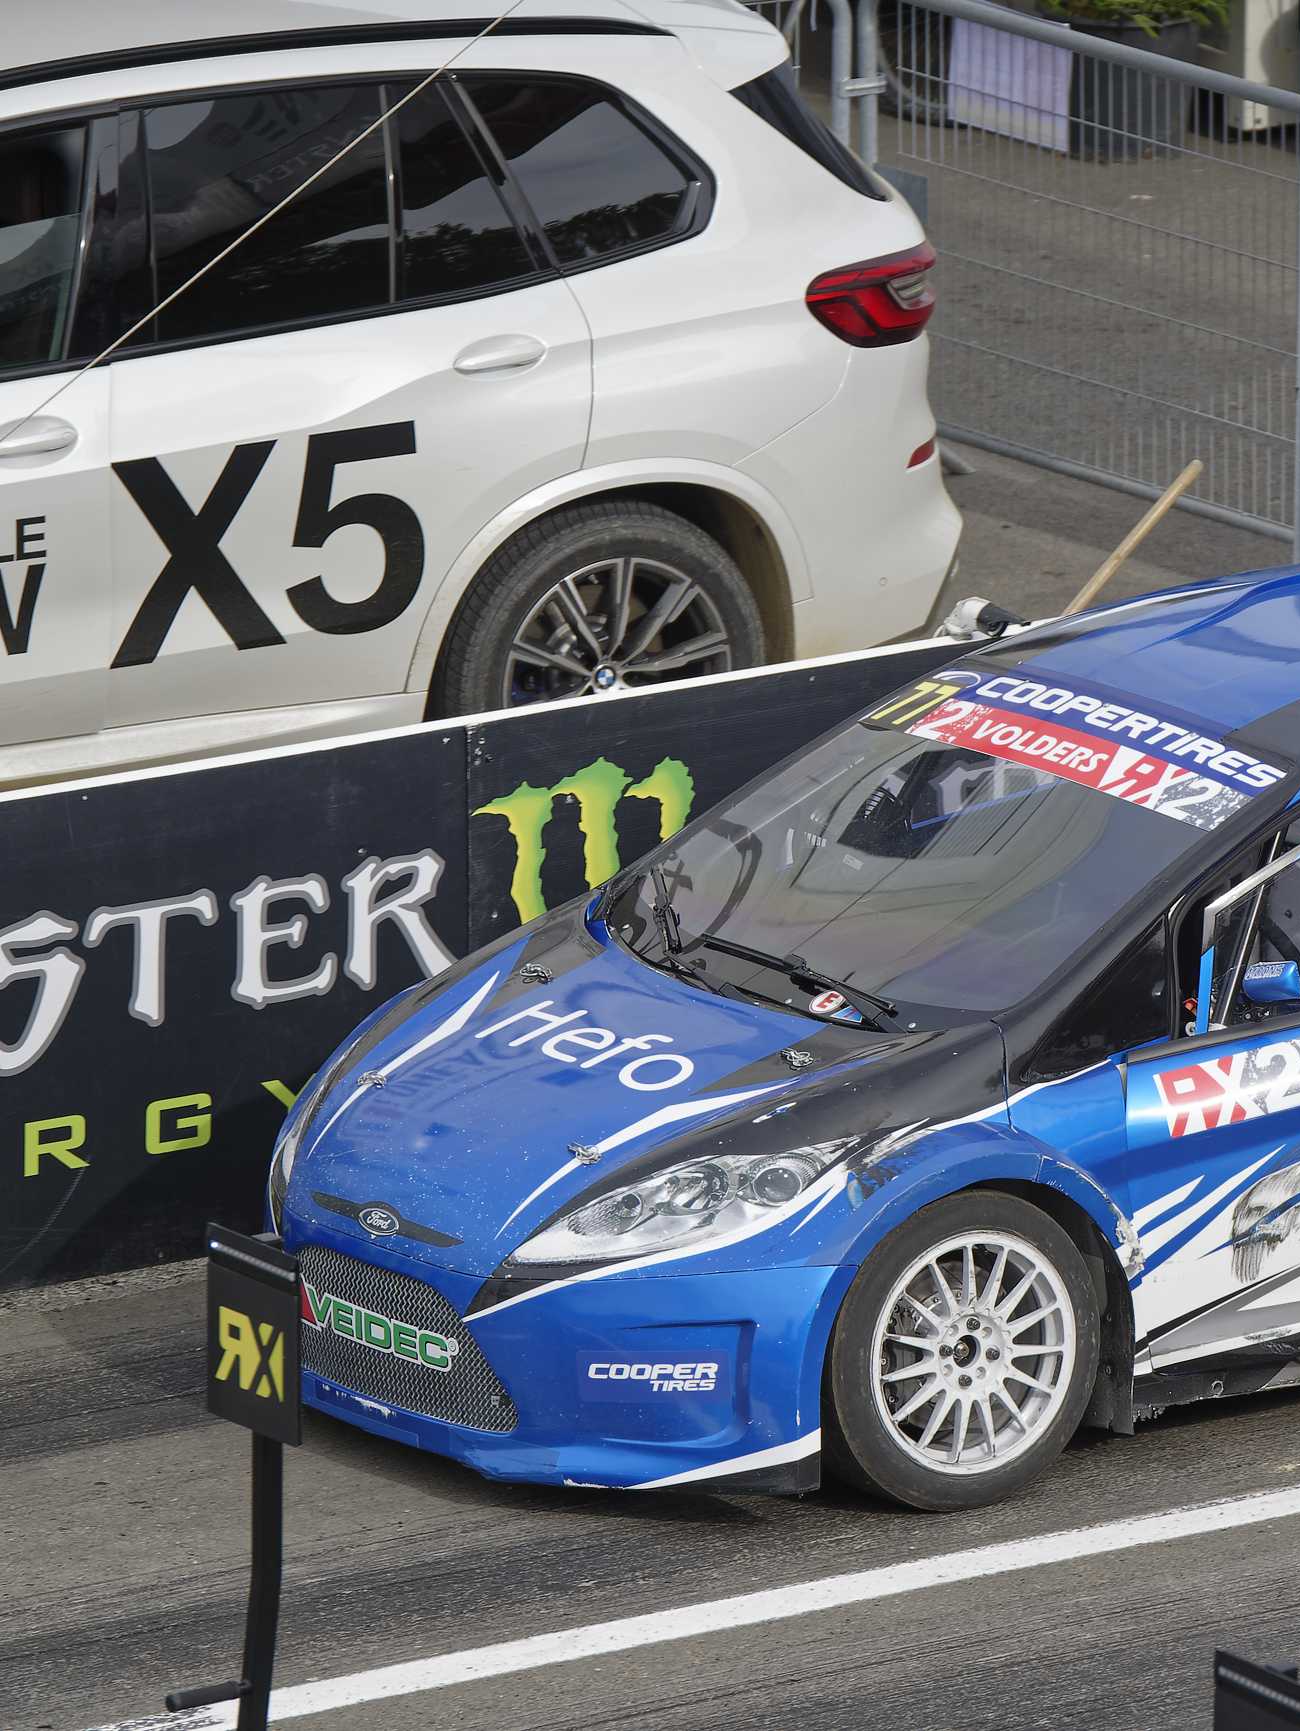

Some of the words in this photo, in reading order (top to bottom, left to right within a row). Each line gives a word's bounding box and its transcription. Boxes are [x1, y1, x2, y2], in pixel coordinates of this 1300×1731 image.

[110, 420, 426, 670] X5
[972, 718, 1109, 773] VOLDERS
[475, 1000, 695, 1091] Hefo
[367, 1211, 391, 1229] Ford
[307, 1285, 450, 1368] VEIDEC
[588, 1362, 718, 1380] COOPER
[650, 1379, 717, 1392] TIRES
